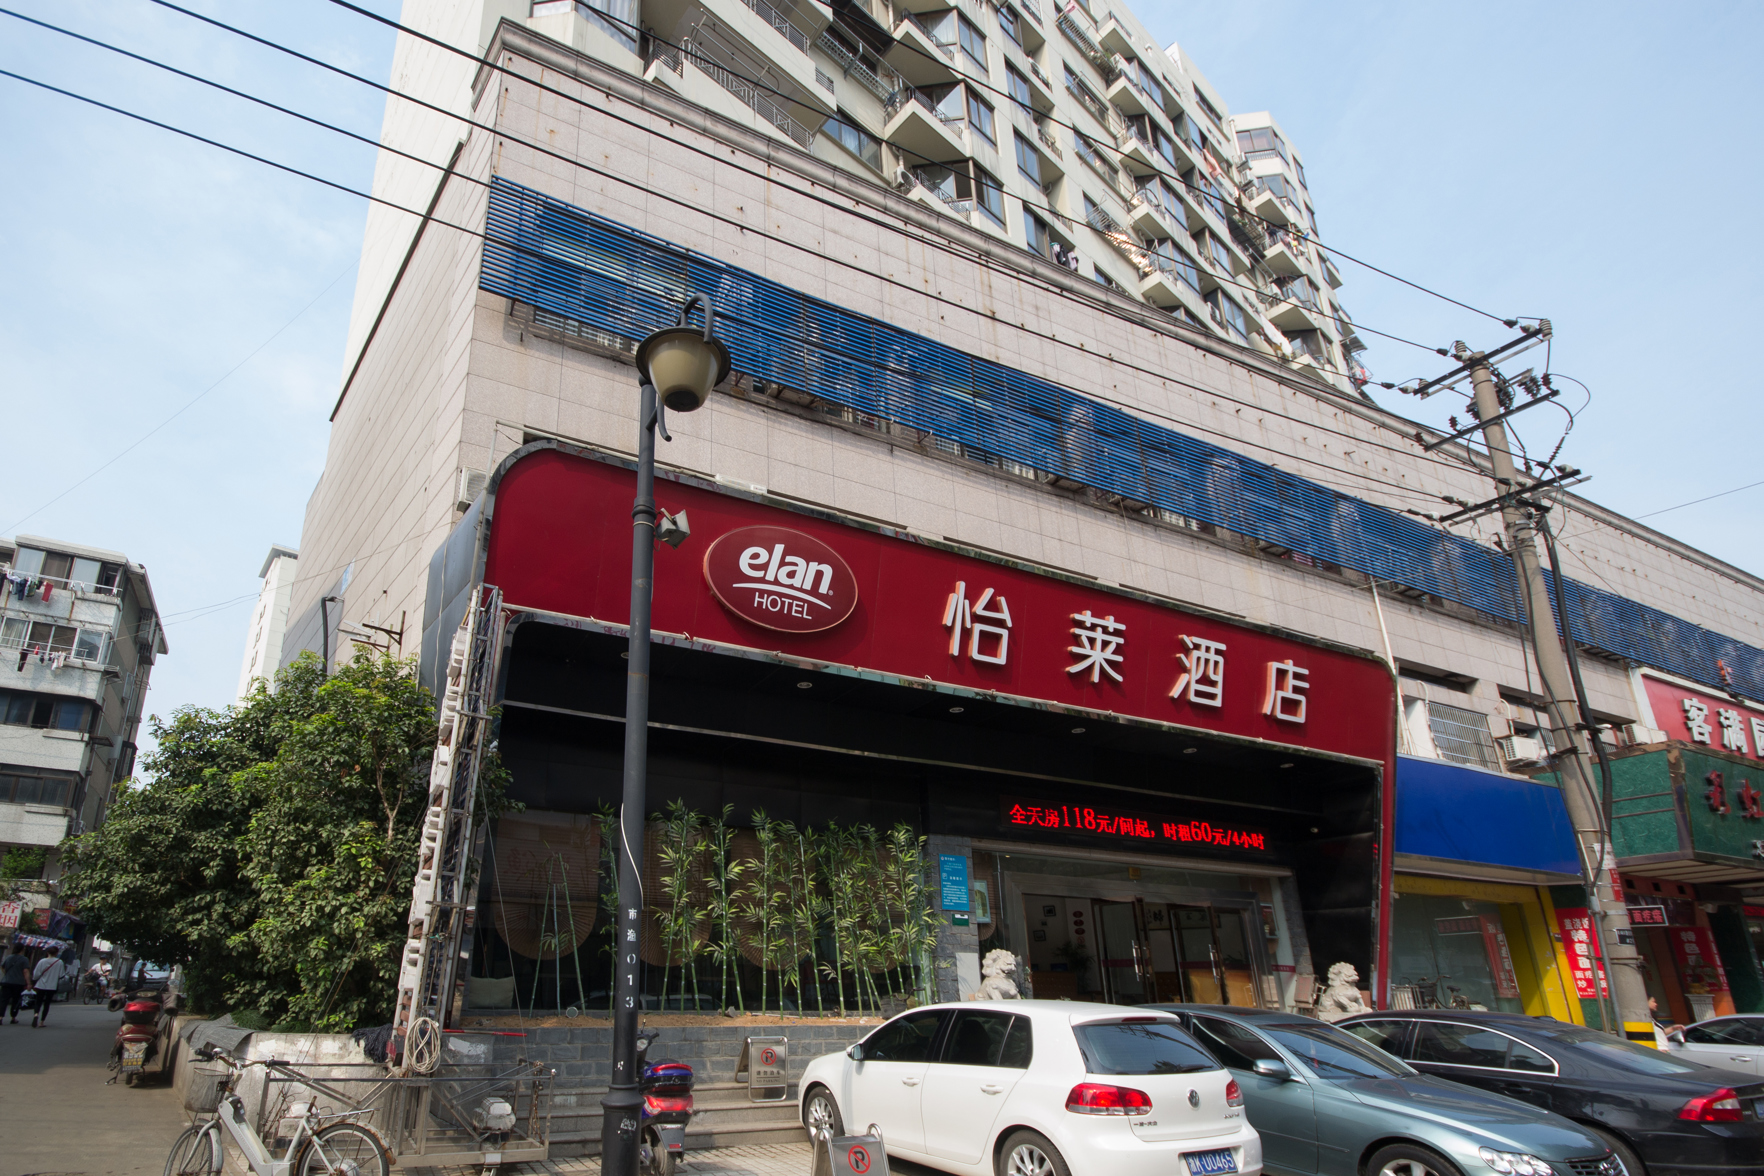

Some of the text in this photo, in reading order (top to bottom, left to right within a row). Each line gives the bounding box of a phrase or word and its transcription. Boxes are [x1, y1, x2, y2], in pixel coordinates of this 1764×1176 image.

[739, 544, 833, 594] elan
[754, 592, 812, 619] HOTEL
[943, 581, 1310, 723] 怡莱酒店
[1627, 909, 1663, 923] 面疙瘩
